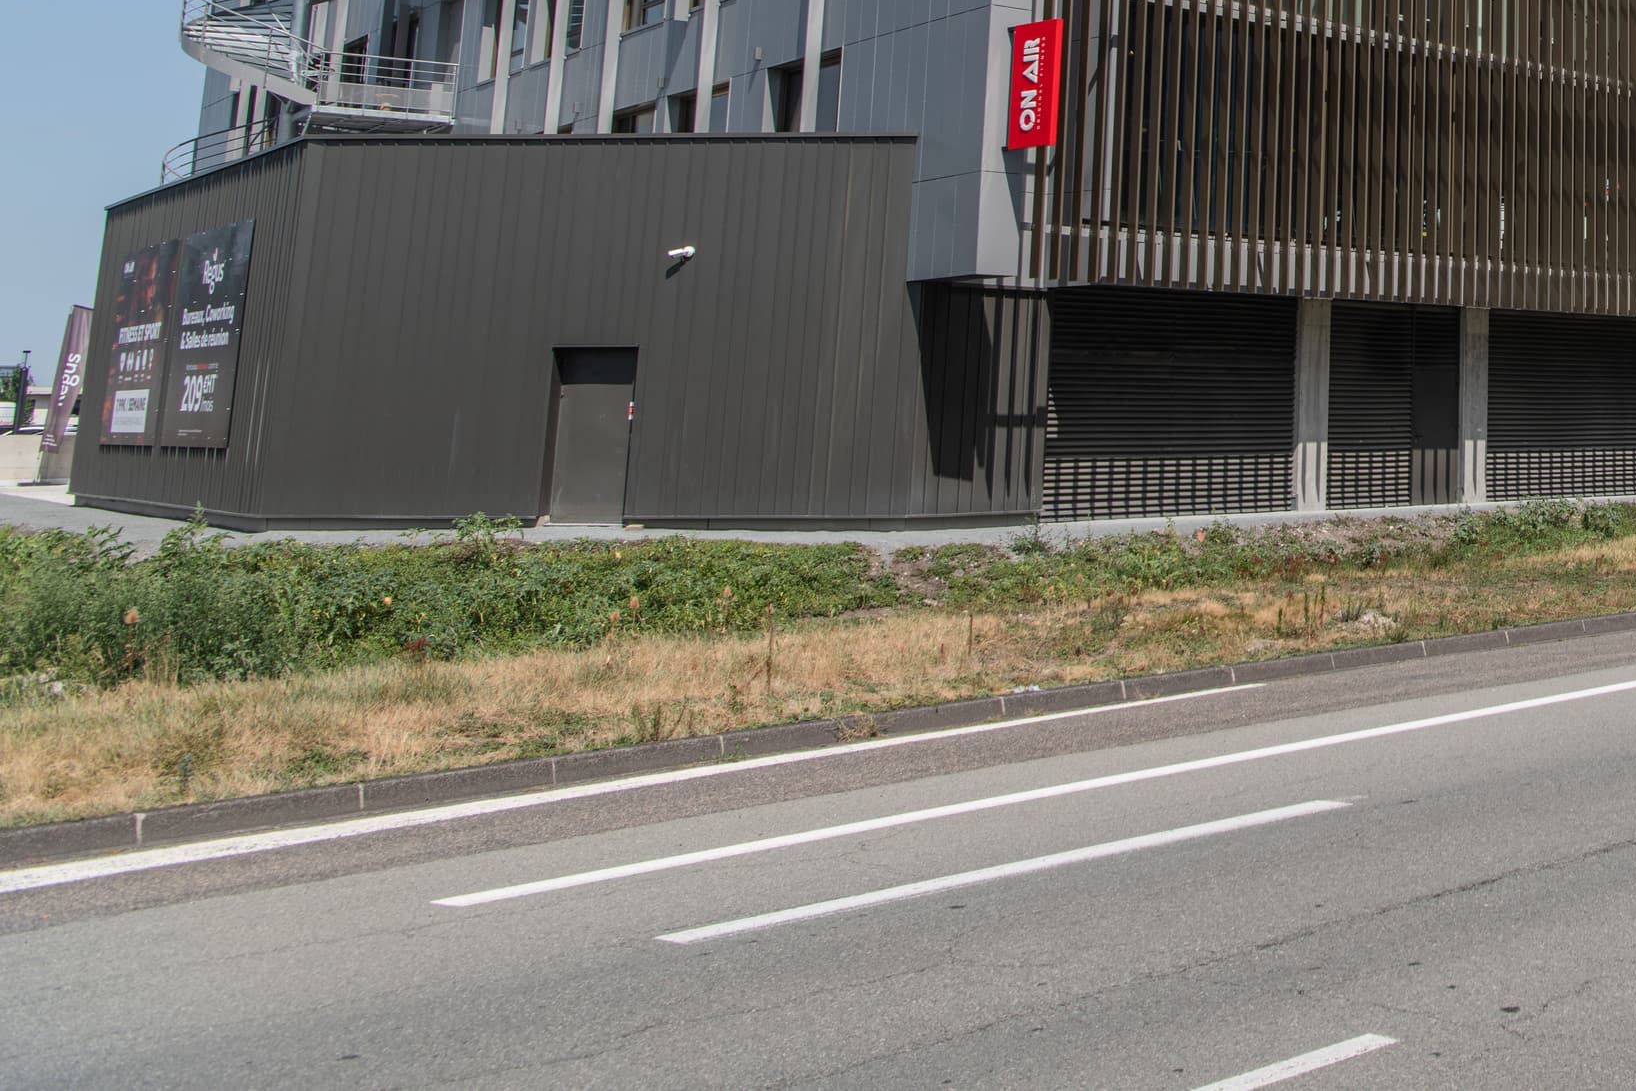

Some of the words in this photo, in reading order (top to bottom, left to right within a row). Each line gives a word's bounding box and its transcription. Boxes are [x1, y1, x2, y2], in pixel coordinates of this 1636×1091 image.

[1022, 37, 1040, 84] AIR
[1019, 90, 1037, 131] ON
[202, 259, 226, 294] Regus
[180, 375, 203, 412] 209
